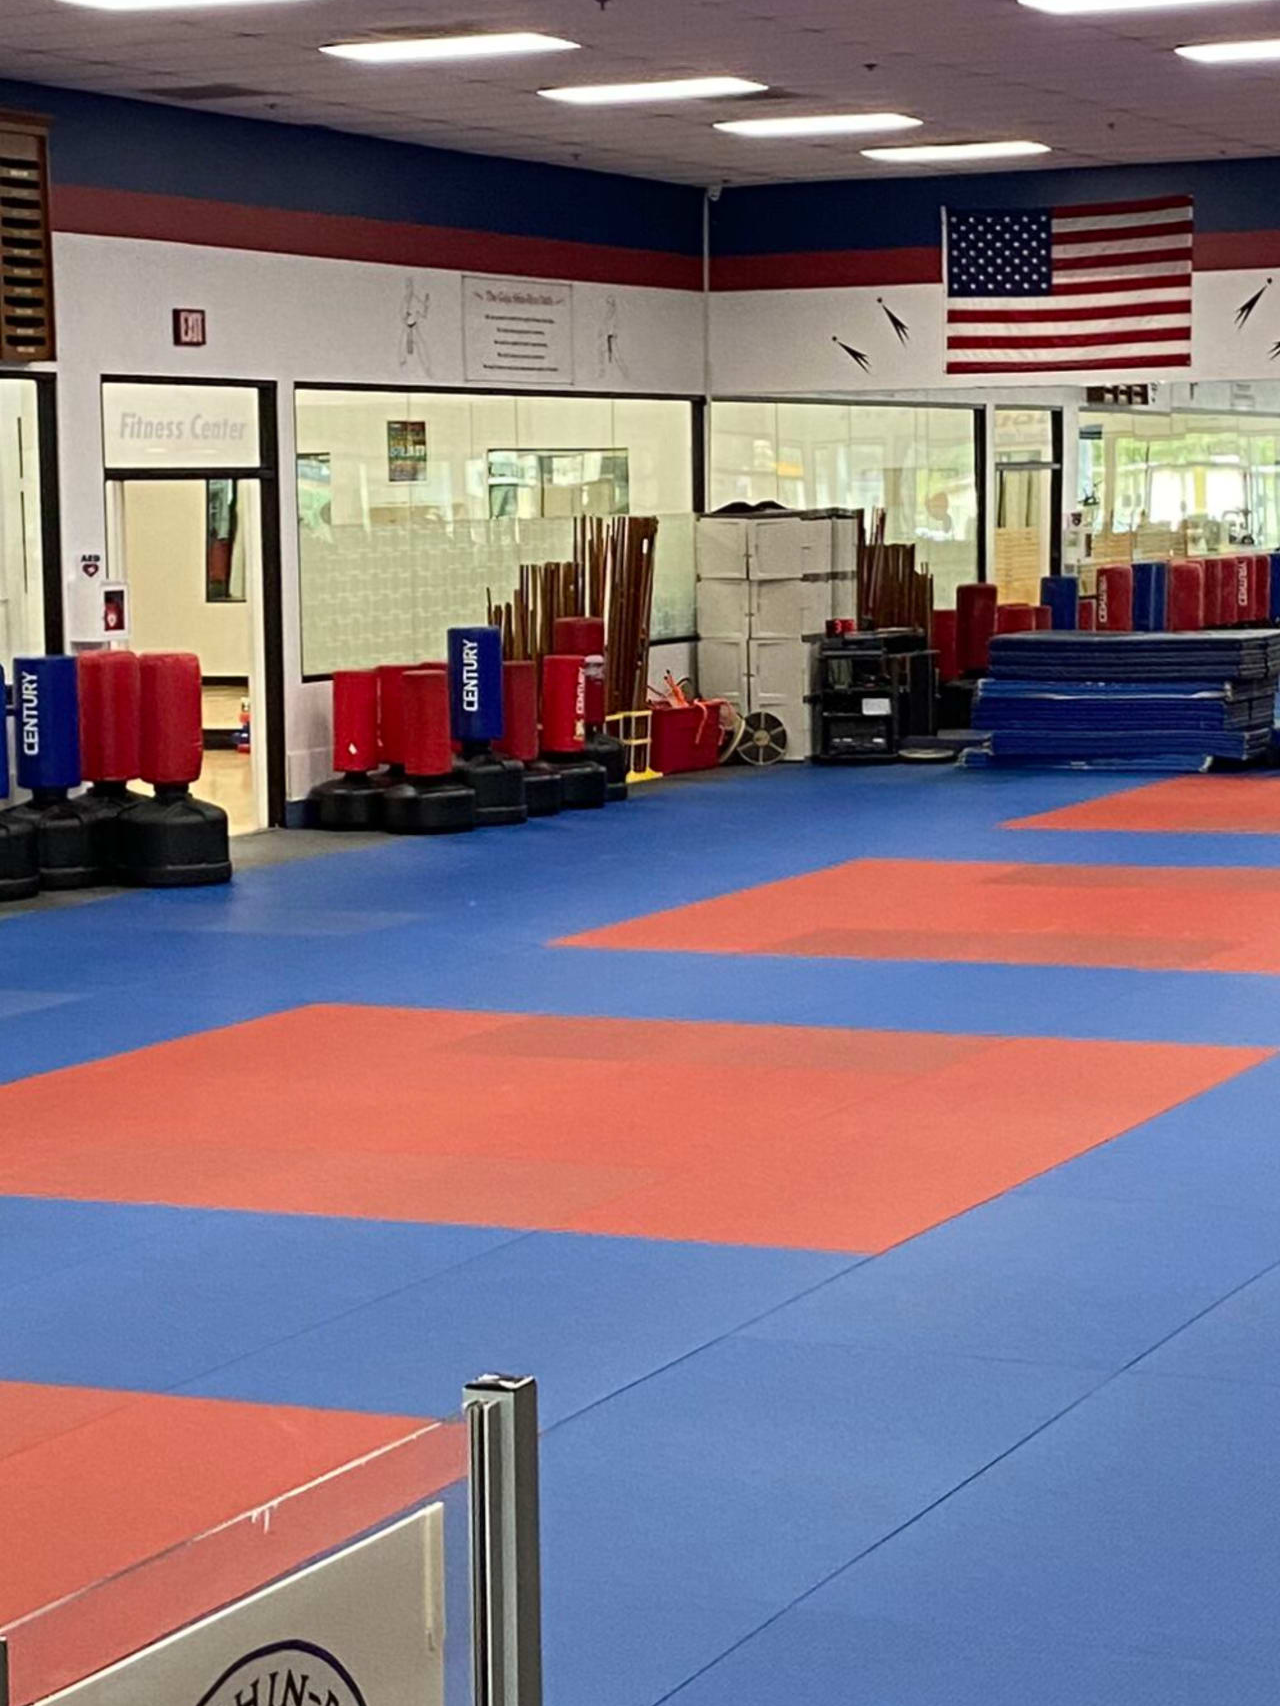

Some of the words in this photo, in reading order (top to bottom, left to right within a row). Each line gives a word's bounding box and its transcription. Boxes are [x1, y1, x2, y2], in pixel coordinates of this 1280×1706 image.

[120, 412, 184, 440] Fitness
[190, 414, 247, 440] Center
[81, 554, 101, 562] AED
[463, 640, 478, 711] CENTURY
[22, 672, 38, 755] CENTURY
